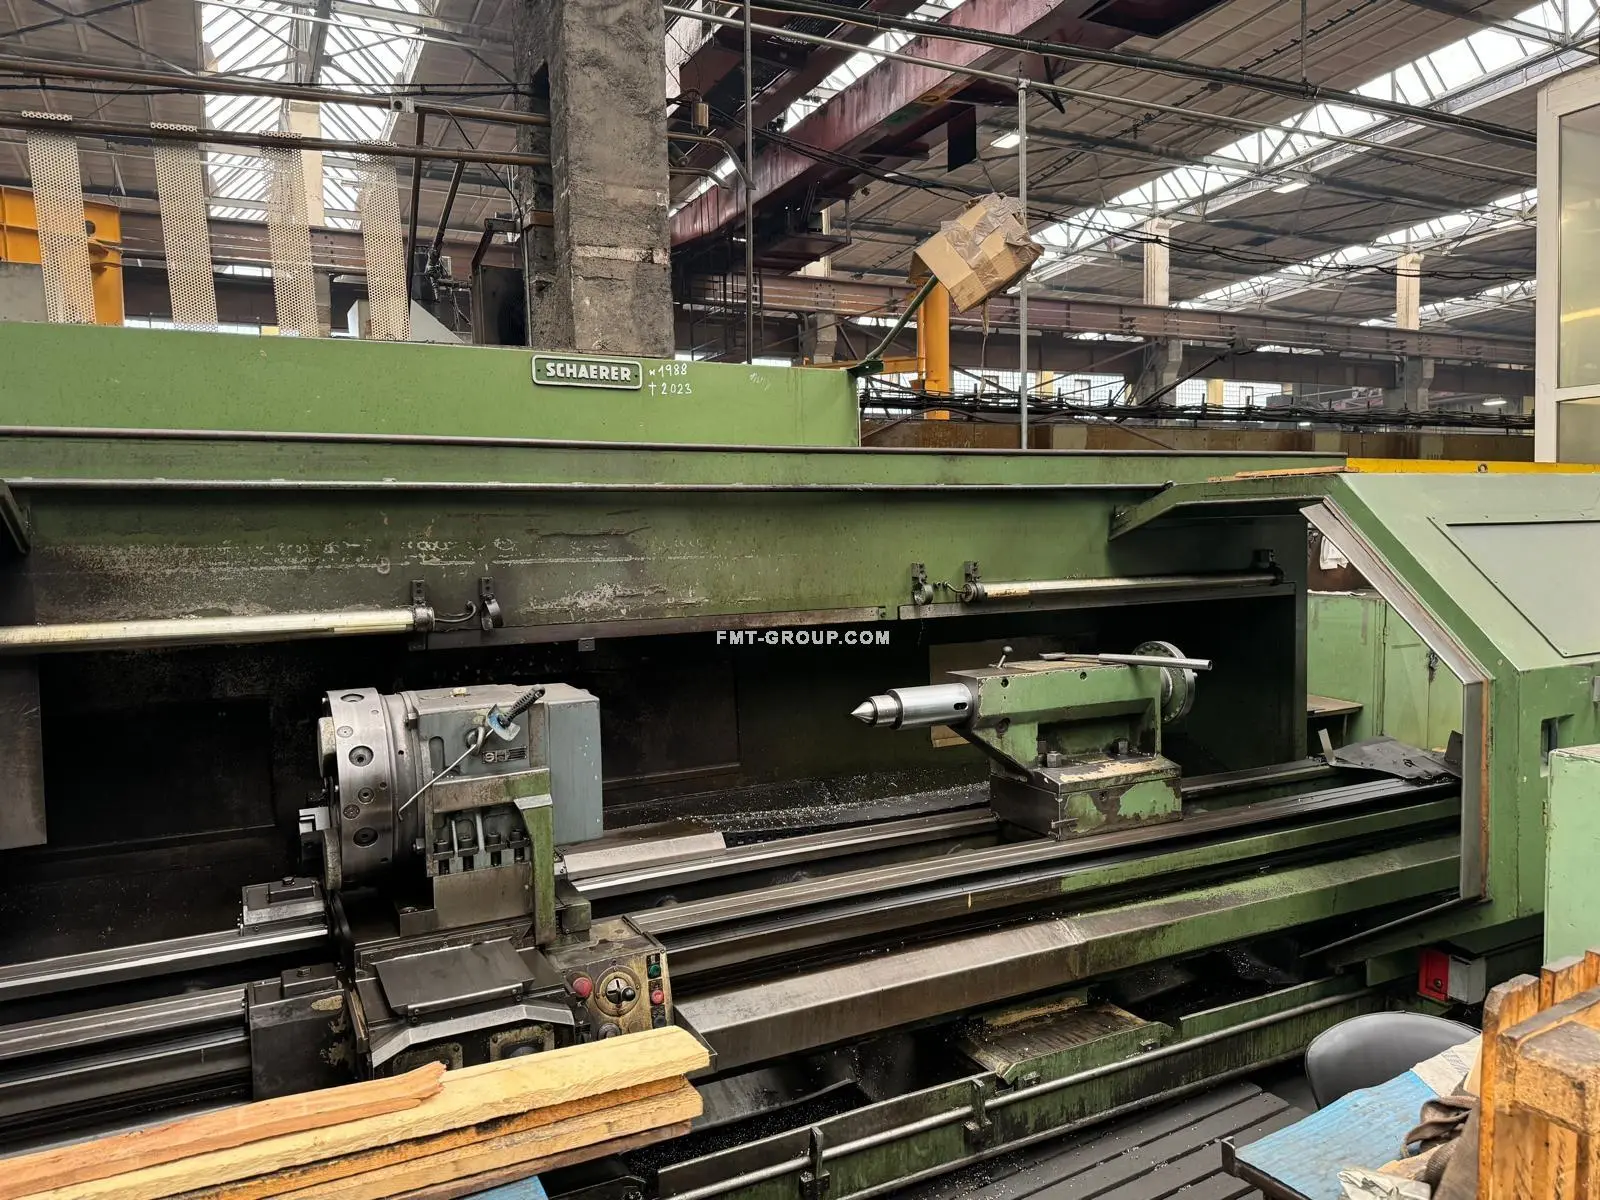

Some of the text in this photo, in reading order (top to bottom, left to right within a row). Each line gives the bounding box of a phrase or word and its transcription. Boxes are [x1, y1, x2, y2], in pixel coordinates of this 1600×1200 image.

[545, 362, 632, 382] SCHAERER
[657, 362, 688, 378] 1988
[661, 382, 692, 395] 2023
